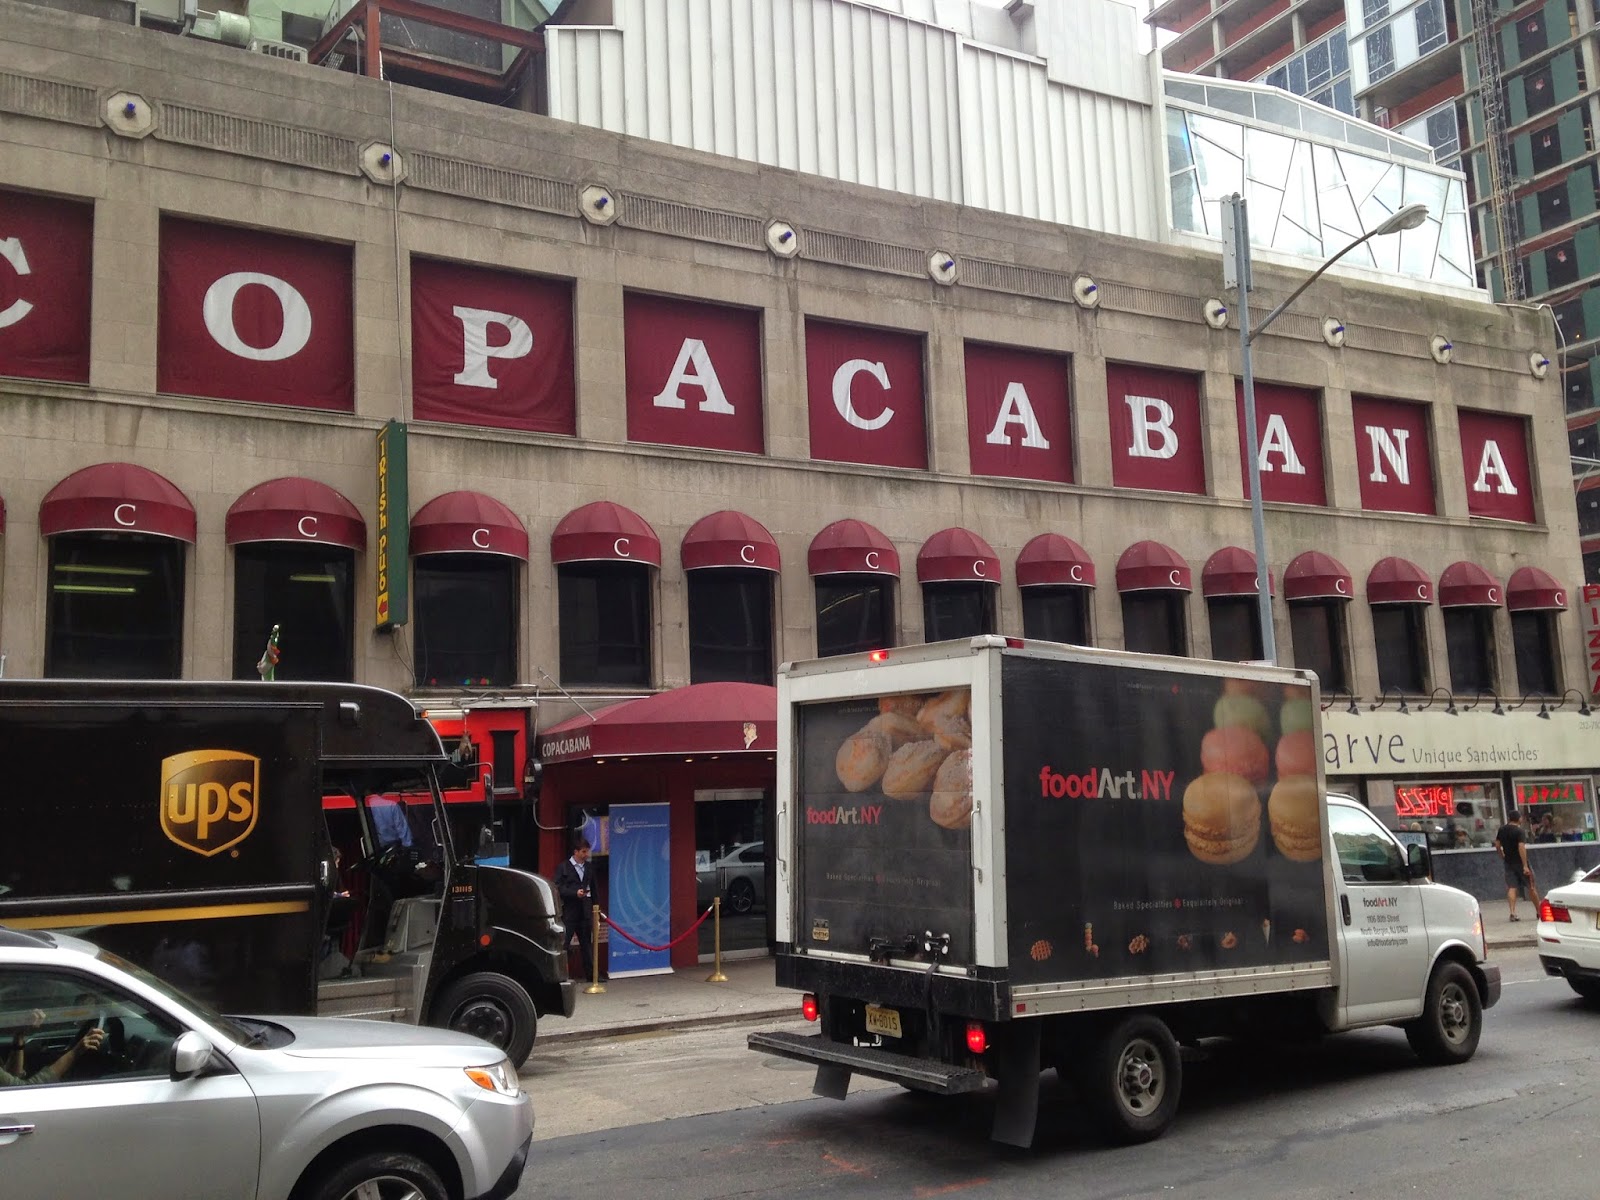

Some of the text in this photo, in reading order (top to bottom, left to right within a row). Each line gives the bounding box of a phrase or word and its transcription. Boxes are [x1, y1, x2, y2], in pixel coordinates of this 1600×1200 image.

[114, 504, 135, 526] C
[298, 517, 318, 537] C
[472, 529, 490, 548] C
[613, 538, 630, 556] C
[740, 545, 755, 563] C
[865, 552, 879, 569] C
[973, 560, 985, 577] C
[1070, 565, 1083, 581] C
[1169, 570, 1181, 586] C
[542, 735, 591, 757] COPACABANA
[1412, 748, 1462, 768] Unique
[1467, 743, 1538, 764] Sandwiches
[1039, 765, 1175, 800] foodArt.NY
[168, 782, 252, 839] ups
[806, 805, 883, 825] foodArt.NY
[1113, 900, 1134, 910] Baked
[1136, 900, 1173, 911] Specialties
